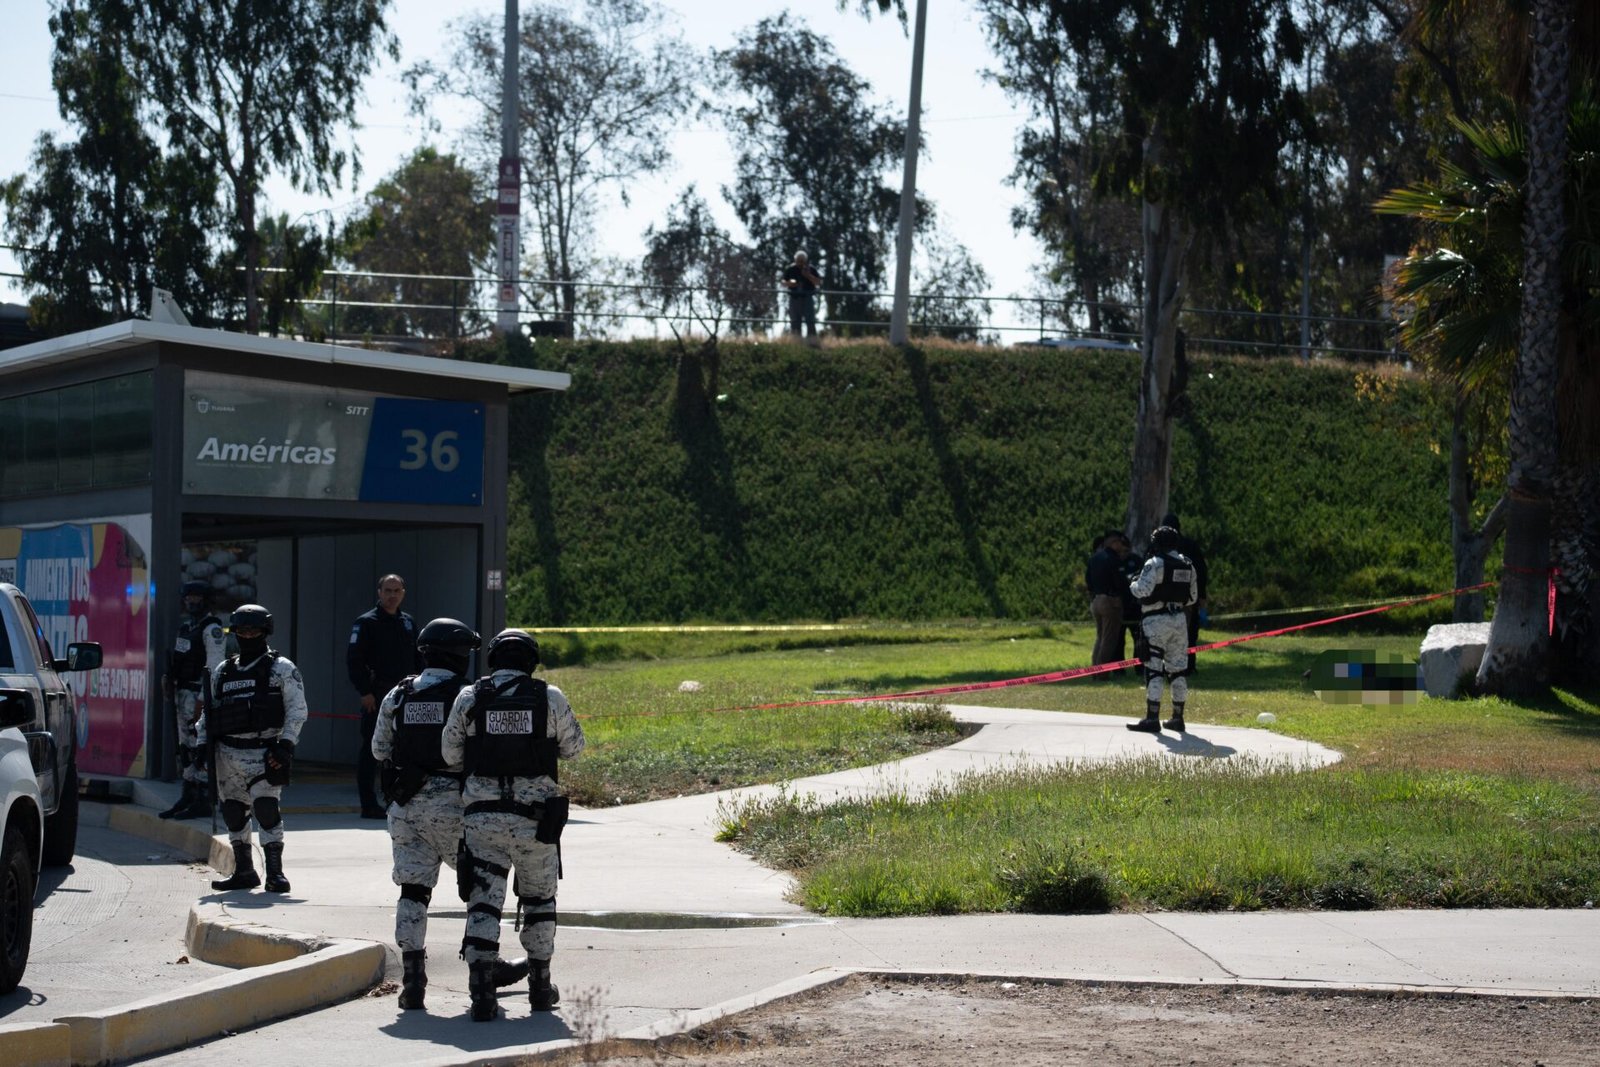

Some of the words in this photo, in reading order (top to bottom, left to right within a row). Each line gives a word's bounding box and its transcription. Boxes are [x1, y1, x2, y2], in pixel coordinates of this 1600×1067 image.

[346, 405, 369, 416] SITT
[196, 437, 337, 465] Américas
[400, 429, 460, 472] 36
[25, 558, 69, 601] AUMENTA
[71, 557, 91, 602] TUS
[100, 668, 109, 699] 55
[408, 704, 439, 713] GUARDIA
[406, 713, 442, 723] NACIONAL
[489, 711, 530, 723] GUARDIA
[488, 723, 530, 733] NACIONAL
